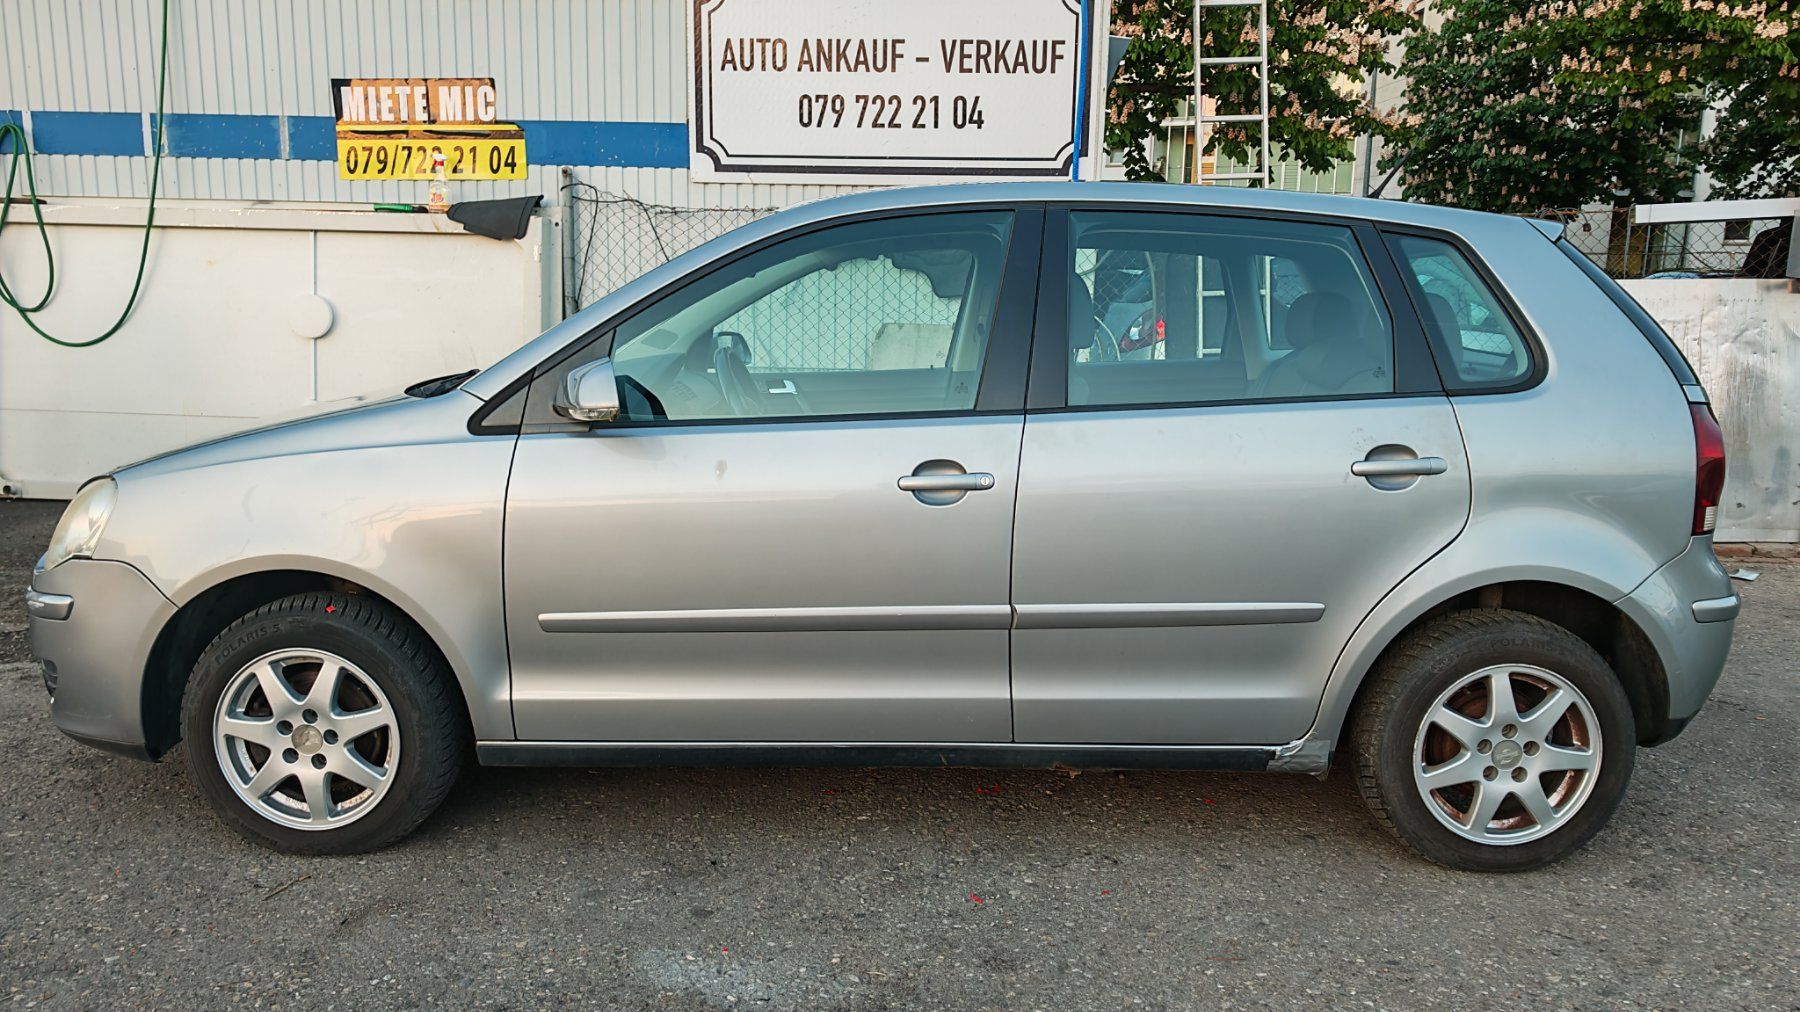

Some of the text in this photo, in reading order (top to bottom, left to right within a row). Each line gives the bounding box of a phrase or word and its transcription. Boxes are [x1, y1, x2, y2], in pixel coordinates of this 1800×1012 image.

[720, 38, 788, 72] AUTO
[796, 38, 906, 73] ANKAUF
[940, 39, 1066, 74] VERKAUF
[340, 85, 496, 122] MIETE MIC
[798, 94, 985, 130] 079 722 21 04
[452, 145, 477, 174] 21
[489, 145, 517, 175] 04
